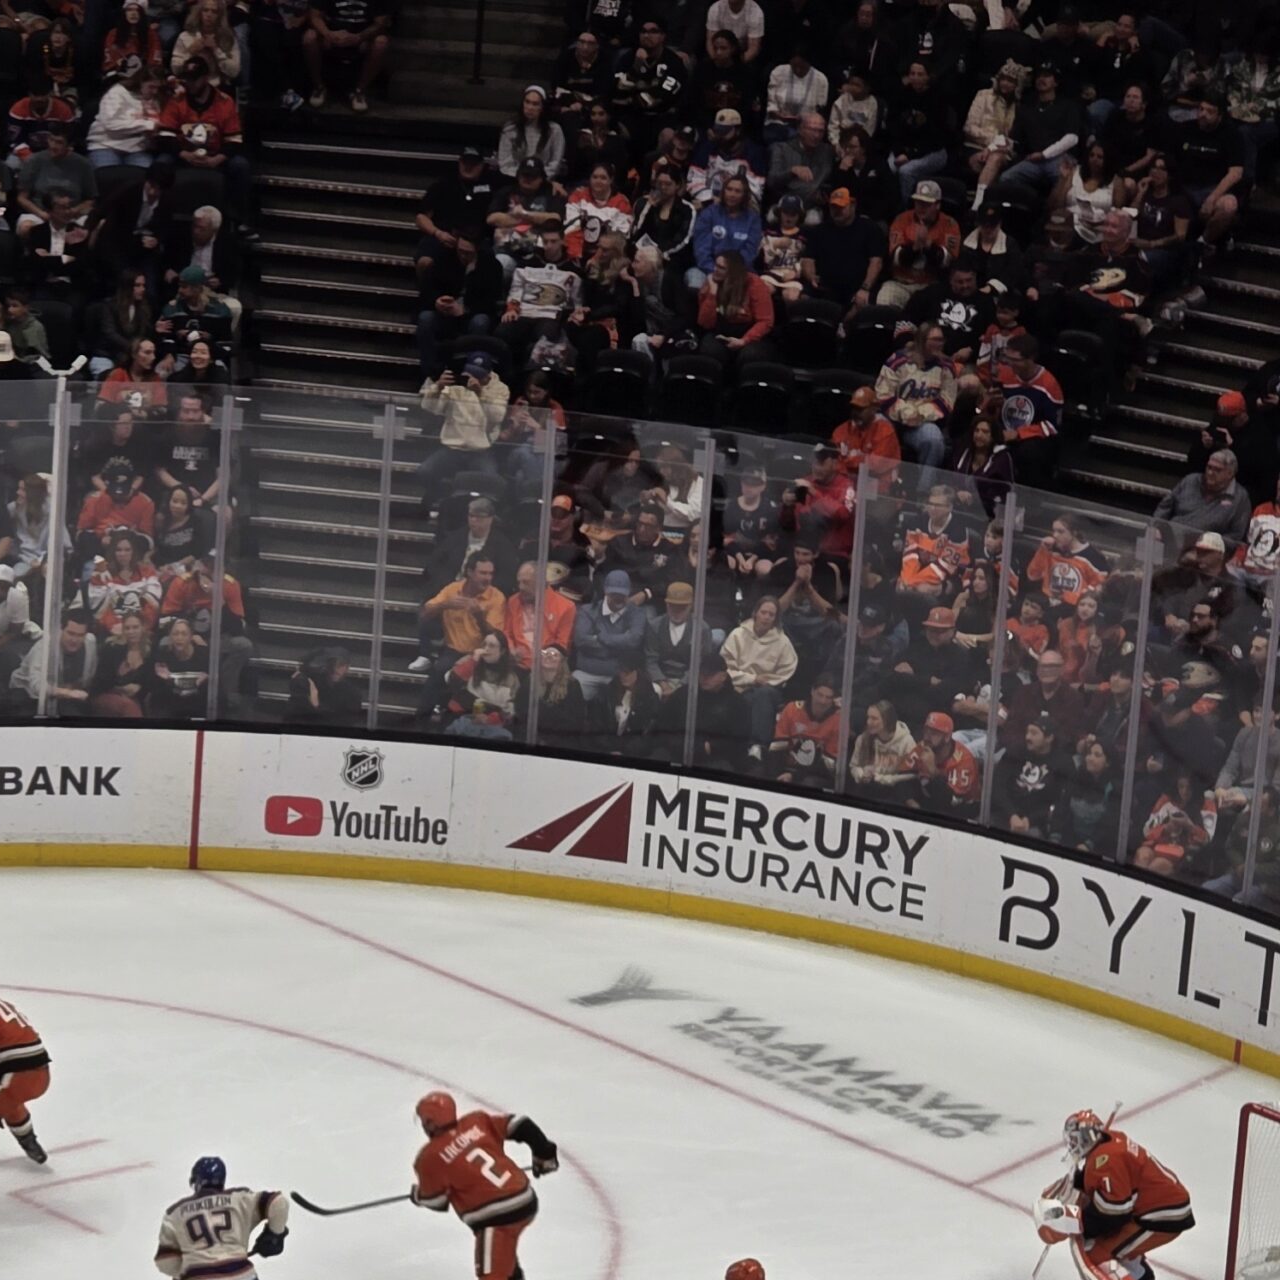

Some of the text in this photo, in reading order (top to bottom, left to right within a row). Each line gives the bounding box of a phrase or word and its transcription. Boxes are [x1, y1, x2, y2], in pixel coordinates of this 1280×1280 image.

[330, 800, 449, 846] YouTube
[645, 783, 930, 876] MERCURY
[642, 832, 927, 921] INSURANCE
[465, 1147, 512, 1189] 2
[185, 1208, 232, 1248] 92
